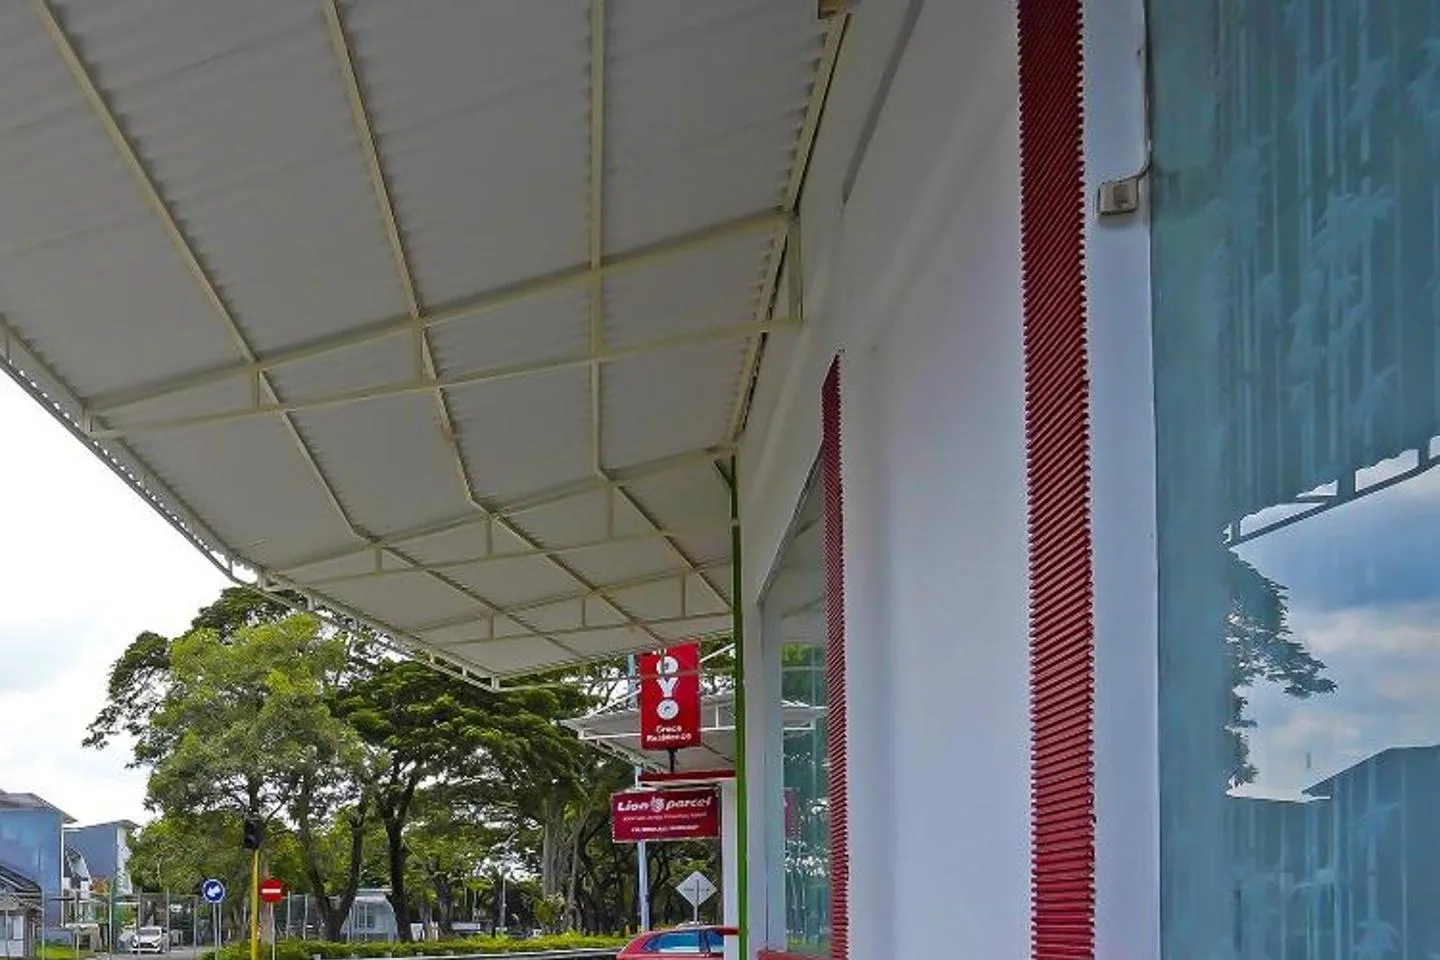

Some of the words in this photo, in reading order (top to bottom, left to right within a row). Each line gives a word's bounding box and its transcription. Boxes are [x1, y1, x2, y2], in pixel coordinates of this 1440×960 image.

[656, 655, 679, 720] OYO
[617, 800, 650, 812] Lion
[665, 796, 712, 811] parcel
